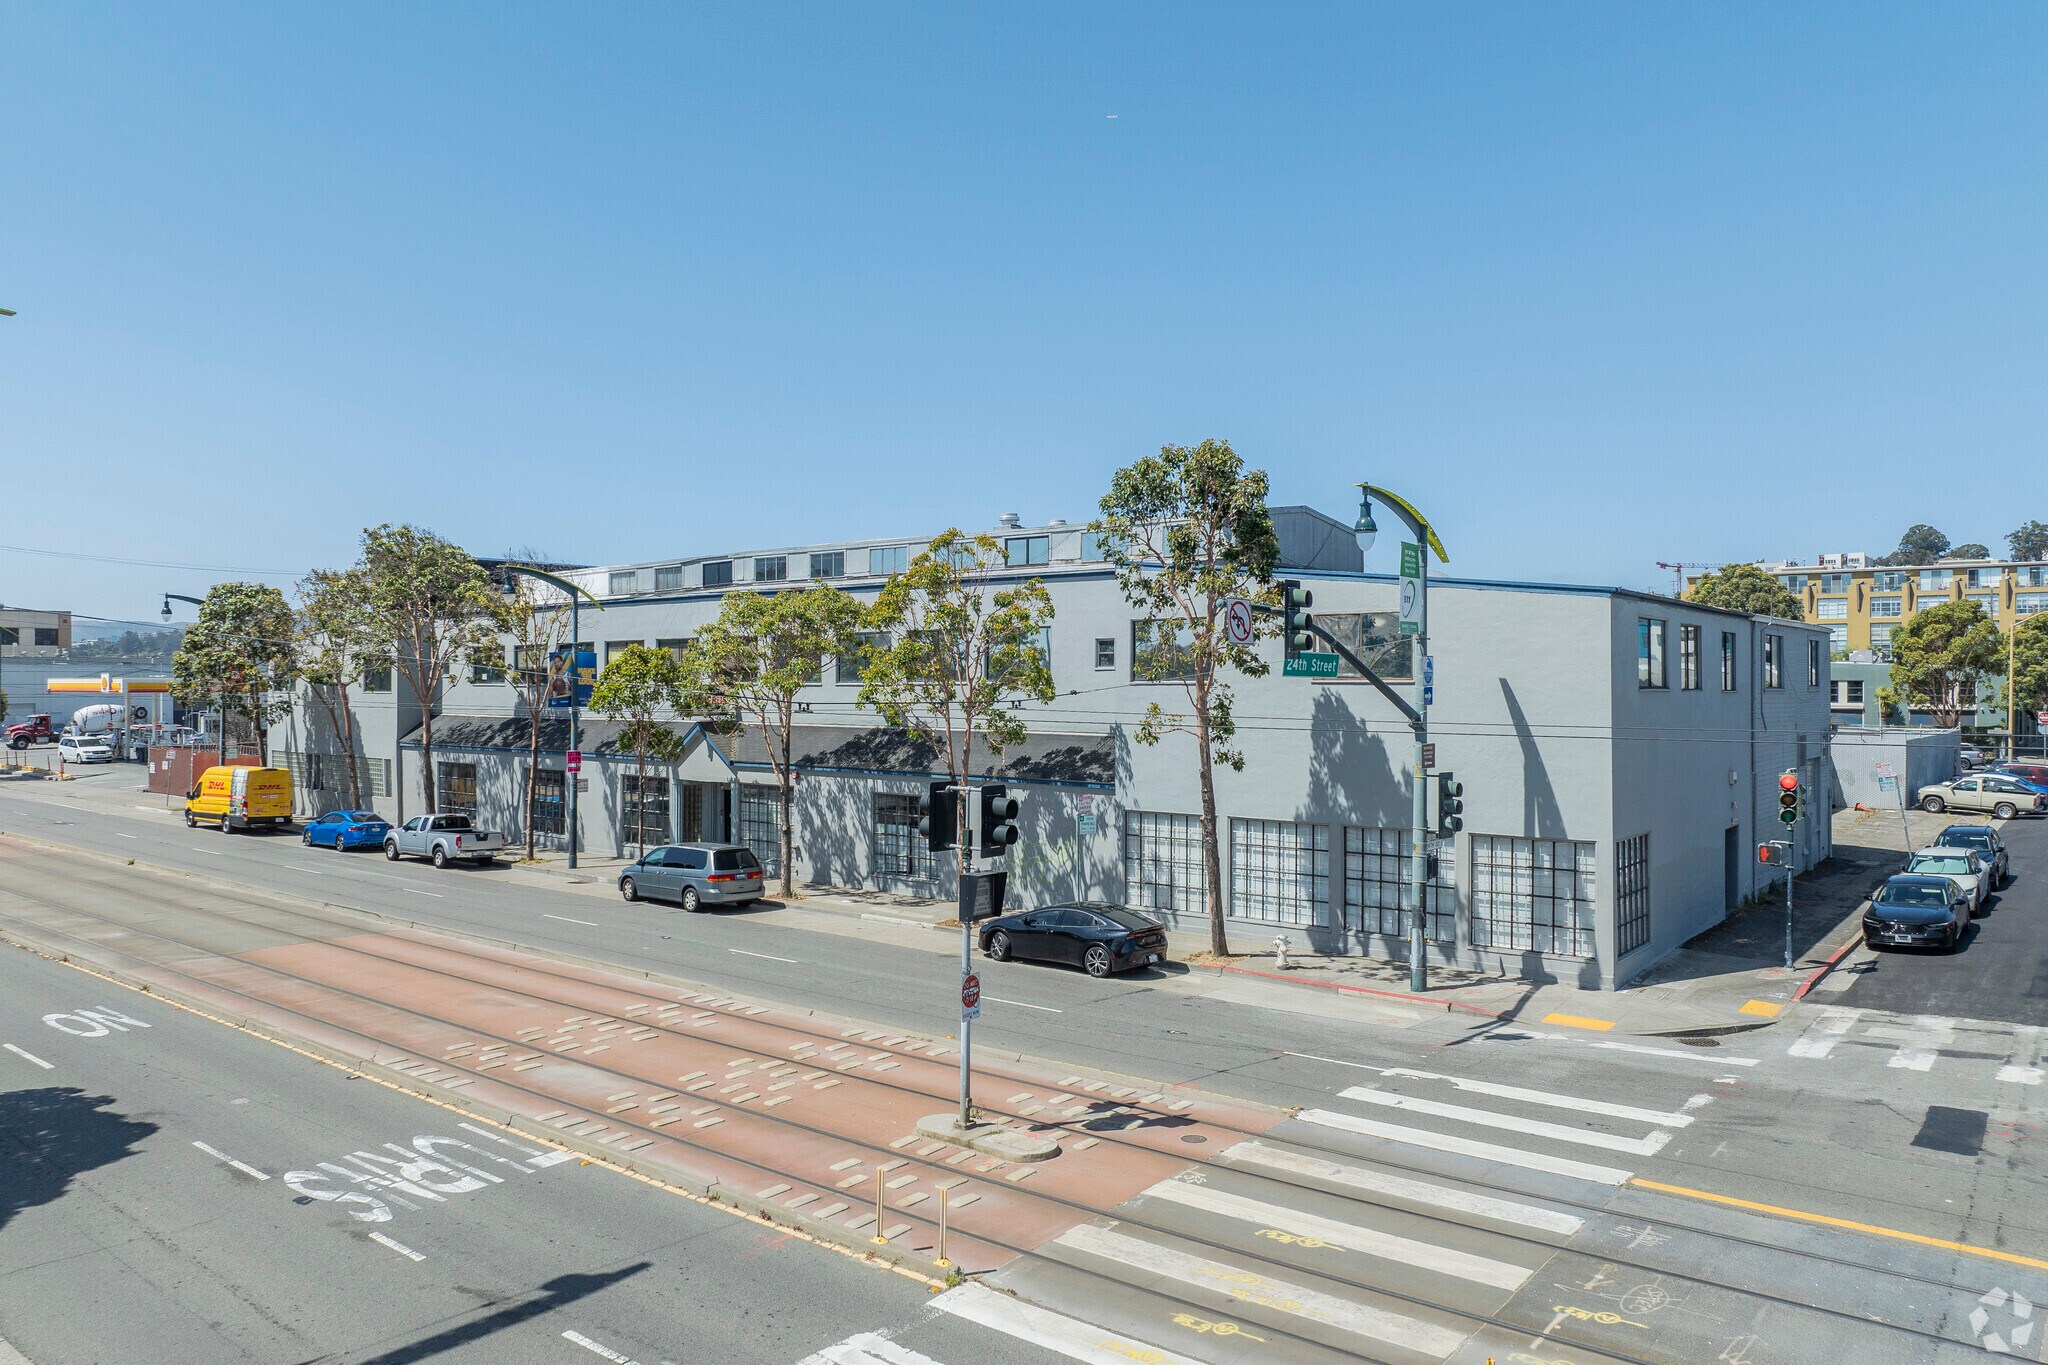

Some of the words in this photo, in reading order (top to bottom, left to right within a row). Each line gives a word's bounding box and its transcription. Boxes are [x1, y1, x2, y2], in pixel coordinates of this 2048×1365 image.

[1403, 595, 1411, 604] 511
[1286, 658, 1307, 671] 24th
[1311, 658, 1337, 672] Street
[208, 781, 225, 790] DHL
[284, 1123, 578, 1222] TURNS
